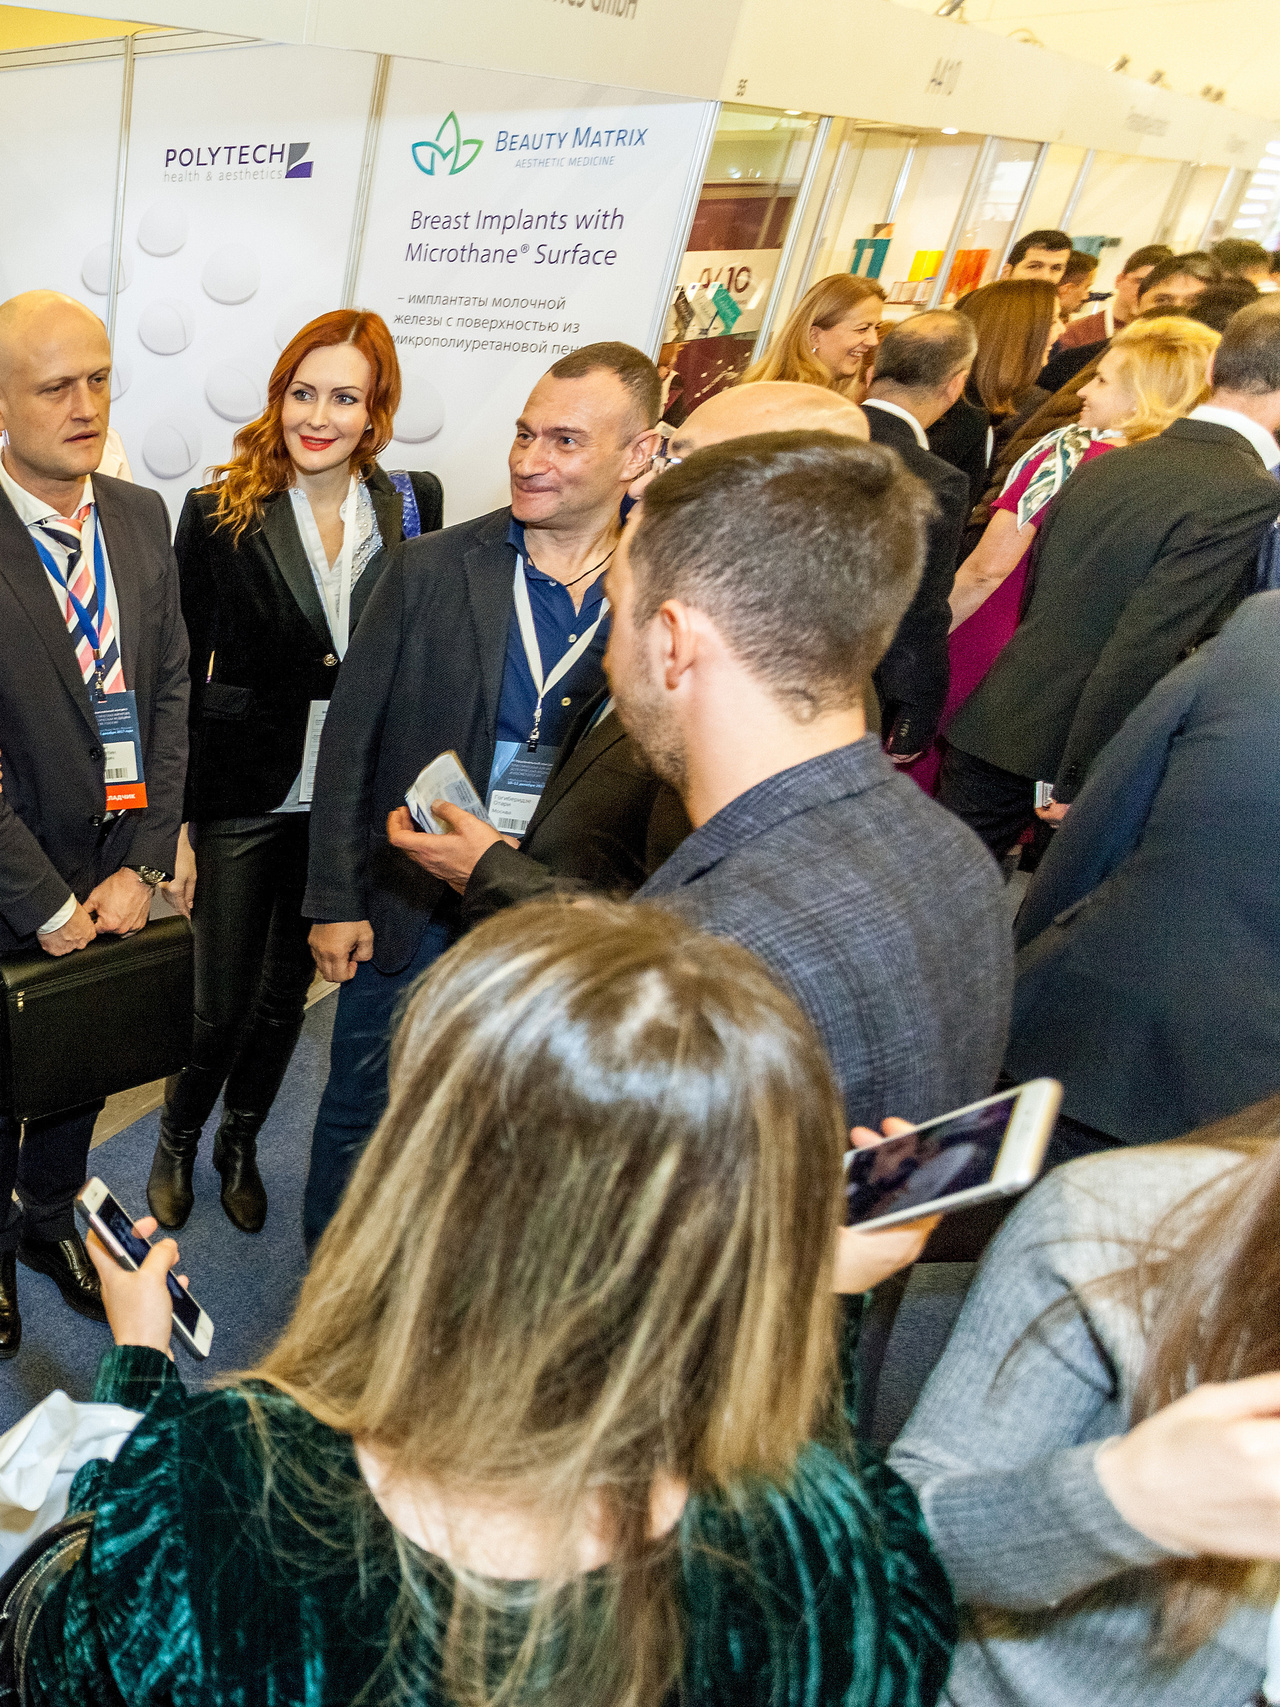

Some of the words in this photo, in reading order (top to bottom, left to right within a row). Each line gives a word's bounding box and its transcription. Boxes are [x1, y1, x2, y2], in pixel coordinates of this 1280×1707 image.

[495, 130, 570, 152] BEAUTY
[572, 127, 649, 149] MATRIX
[165, 143, 286, 167] POLYTECH
[515, 157, 565, 168] AESTHETIC
[568, 155, 616, 167] MEDICINE
[163, 169, 200, 183] health
[206, 171, 212, 181] &
[219, 168, 283, 182] aesthetics
[410, 209, 471, 230] Breast
[475, 208, 567, 235] Implants
[575, 207, 625, 230] with
[534, 242, 618, 266] Surface
[408, 294, 488, 307] имплантаты
[491, 295, 567, 310] молочной
[393, 313, 442, 327] железы
[446, 316, 453, 327] с
[456, 316, 559, 333] поверхностью
[562, 322, 580, 333] из
